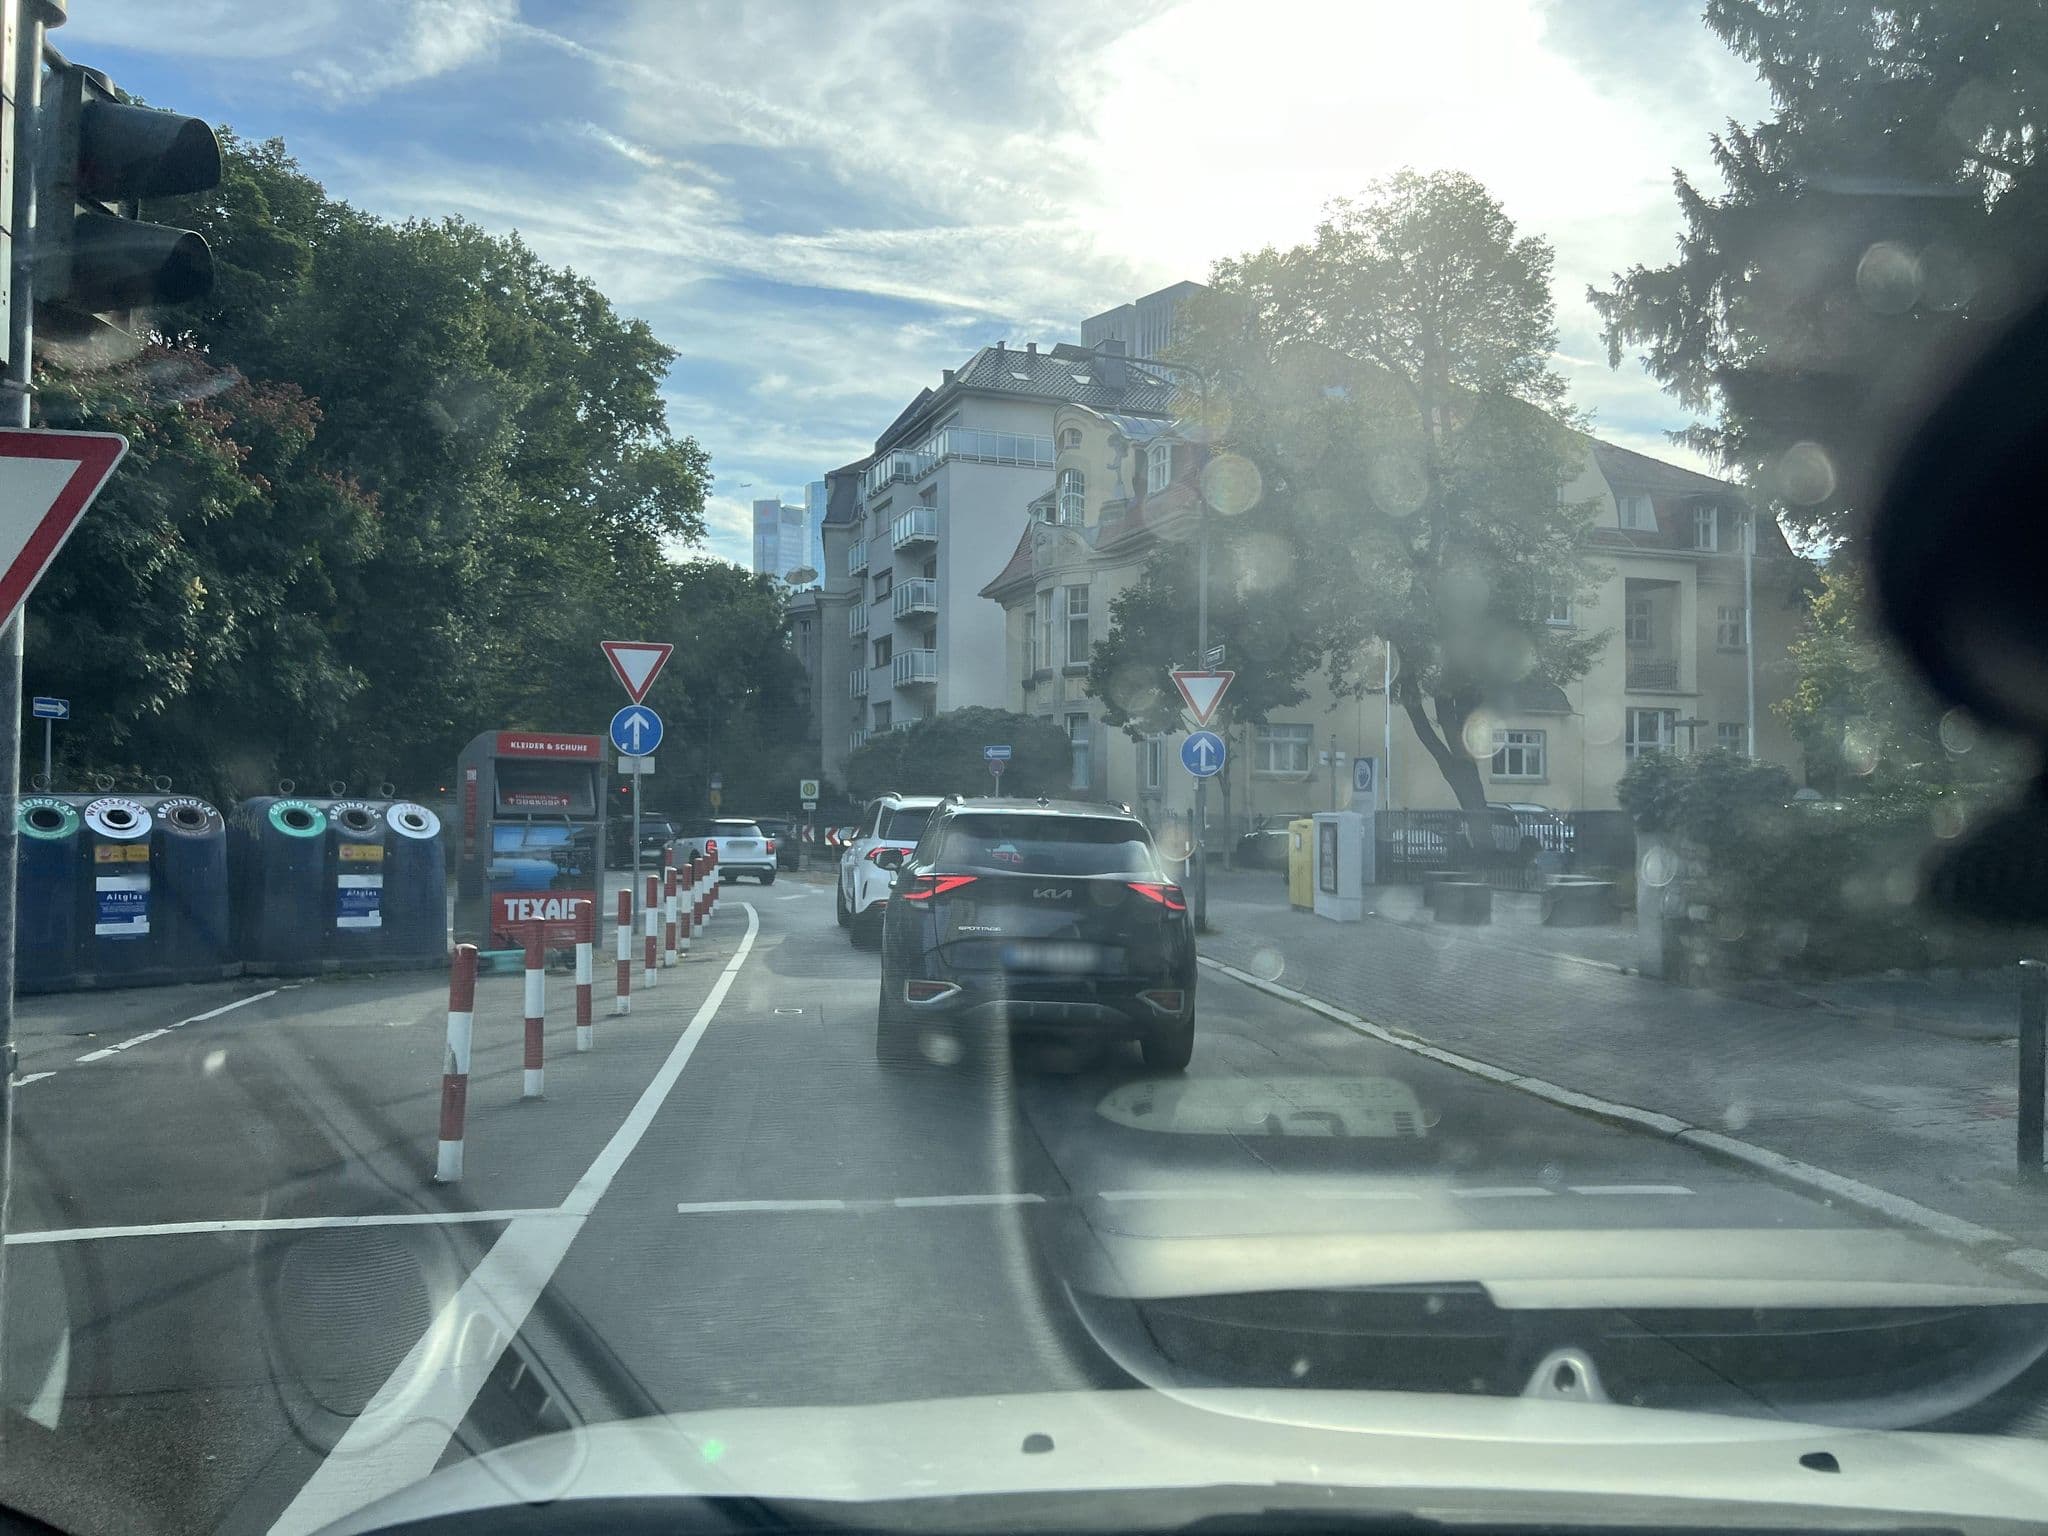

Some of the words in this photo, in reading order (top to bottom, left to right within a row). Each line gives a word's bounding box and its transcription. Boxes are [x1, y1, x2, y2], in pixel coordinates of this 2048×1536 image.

[510, 741, 545, 750] KLEIDER
[555, 743, 588, 752] SCHUHE
[86, 798, 148, 817] WEISSGLAS
[157, 798, 218, 819] BRAUNGLAS
[329, 801, 382, 821] BRAUNGLAS
[106, 892, 143, 902] Altglas
[1032, 888, 1073, 899] KIA
